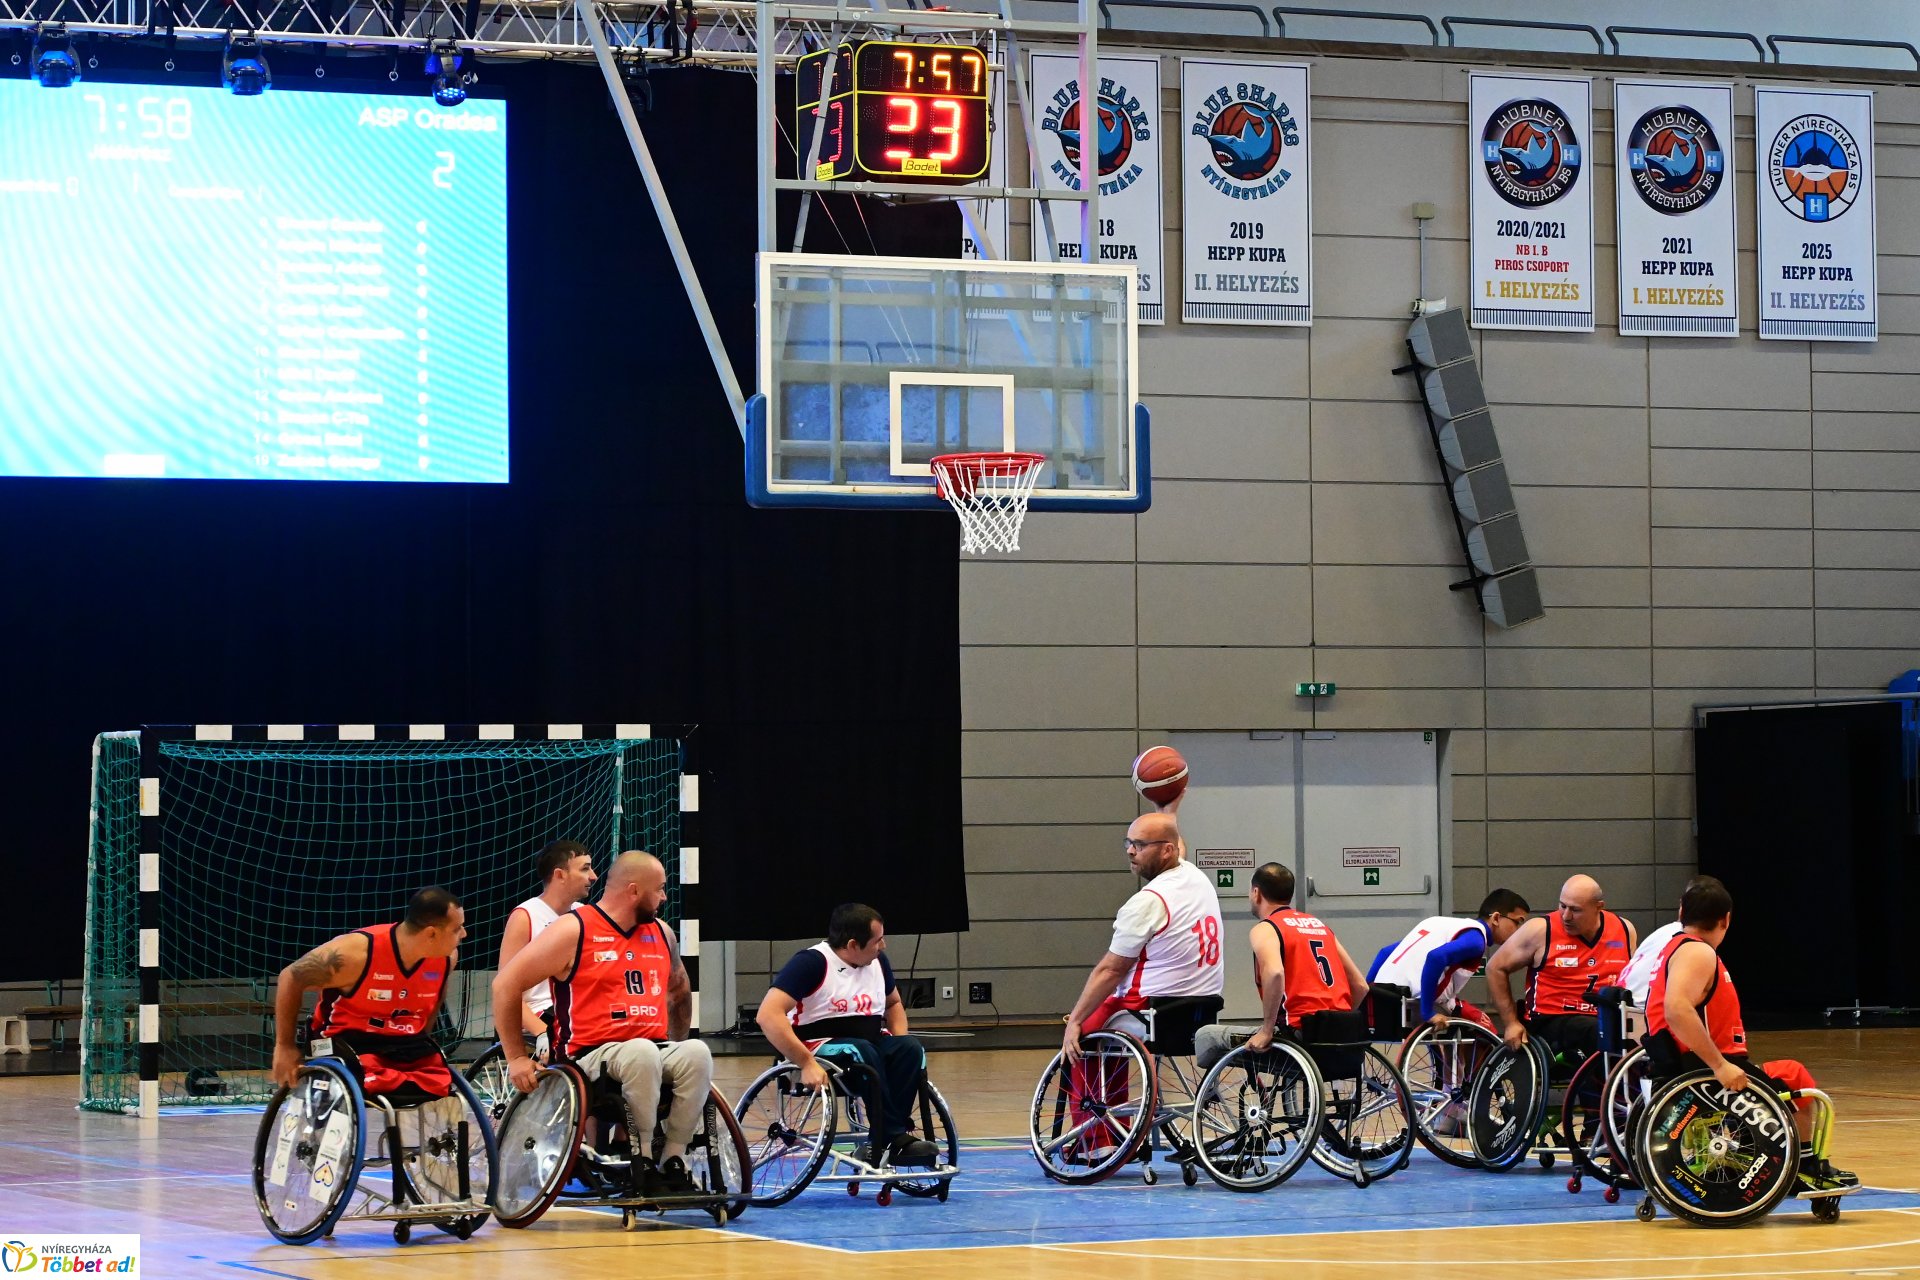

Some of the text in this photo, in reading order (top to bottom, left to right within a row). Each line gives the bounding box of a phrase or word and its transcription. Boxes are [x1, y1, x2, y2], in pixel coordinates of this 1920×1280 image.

[893, 51, 981, 93] 7:57
[83, 94, 192, 140] 7:58
[358, 106, 498, 132] ASP Oradea
[1042, 77, 1150, 141] BLUE HARKS
[1192, 82, 1300, 147] BLUE SHARKS
[1497, 104, 1565, 132] HÜBNER
[1642, 112, 1708, 138] HÜBNER
[1771, 116, 1859, 190] HÜBNER NYÍREGYHÁZA BS
[432, 151, 455, 189] 2
[817, 166, 833, 179] Bodet
[905, 160, 940, 173] Bodet
[1200, 164, 1292, 200] NYÍREGYHÁZA
[1490, 164, 1573, 202] NYÍREGYHÁZA BS
[1636, 171, 1716, 209] NYÍREGYHÁZA BS
[1099, 219, 1115, 236] 18
[1230, 221, 1264, 240] 2019
[1496, 219, 1566, 239] 2020/2021
[1058, 242, 1138, 260] HE KUPA
[1207, 245, 1286, 262] HEPP KUPA
[1516, 244, 1549, 256] NB I. B
[1662, 237, 1693, 254] 2021
[1802, 242, 1833, 260] 2025
[1495, 259, 1569, 272] PIROS CSOPORT
[1642, 260, 1714, 276] HEPP KUPA
[1782, 265, 1853, 281] HEPP KUPA
[1194, 270, 1299, 294] II. HELYEZÉS
[1485, 278, 1580, 300] I. HELYEZÉS
[1633, 283, 1725, 306] I. HELYEZÉS
[1770, 288, 1865, 311] II. HELYEZÉS
[1191, 915, 1220, 968] 18
[1392, 929, 1430, 964] 7
[1309, 939, 1334, 988] 5
[624, 969, 645, 995] 19
[1583, 974, 1599, 993] 7
[629, 1005, 658, 1017] BRD
[853, 994, 872, 1016] 10
[1739, 1152, 1768, 1189] RECARO
